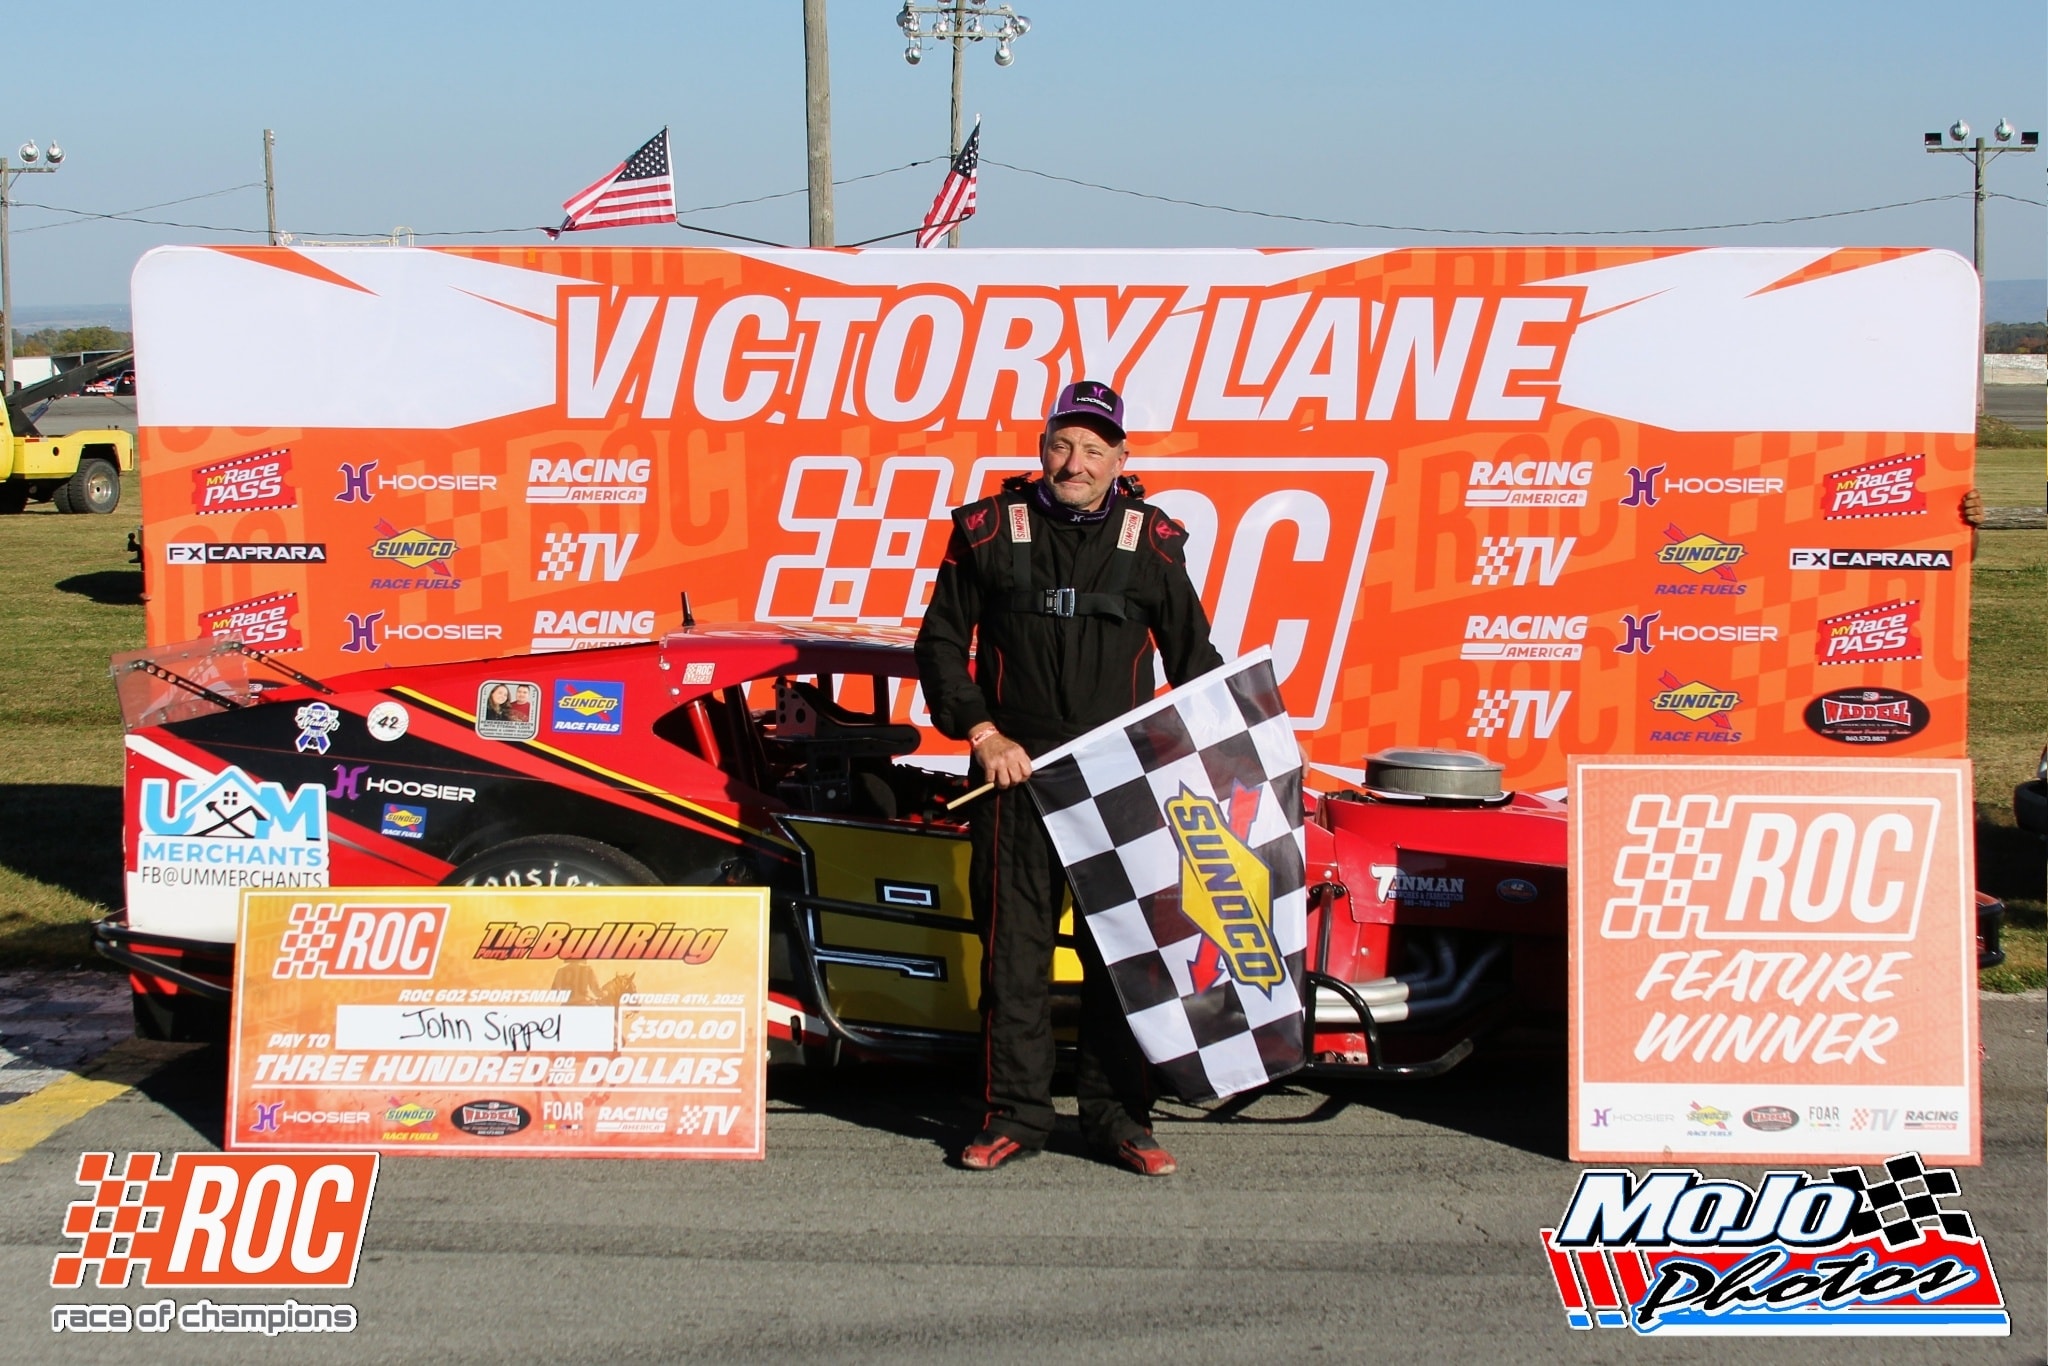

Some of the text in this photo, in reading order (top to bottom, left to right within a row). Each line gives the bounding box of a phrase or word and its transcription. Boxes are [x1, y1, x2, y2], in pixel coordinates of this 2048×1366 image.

[567, 293, 1573, 423] VICTORY LANE
[528, 459, 651, 483] RACING
[1470, 461, 1593, 486] RACING
[204, 478, 282, 507] PASS
[379, 475, 497, 490] HOOSIER
[1664, 478, 1784, 493] HOOSIER
[571, 489, 638, 501] AMERICA
[1512, 492, 1579, 504] AMERICA
[1832, 482, 1914, 512] PASS
[1016, 508, 1027, 540] SIMPSON
[1122, 512, 1139, 548] SIMPSON
[207, 546, 326, 560] CAPRARA
[375, 541, 452, 557] SUNOCO
[578, 533, 640, 582] TV
[1660, 544, 1741, 564] SUNOCO
[1513, 537, 1578, 586] TV
[1833, 552, 1952, 568] CAPRARA
[369, 578, 461, 590] RACE FUELS
[1655, 584, 1747, 595] RACE FUELS
[384, 624, 503, 640] HOOSIER
[533, 611, 654, 635] RACING
[1465, 615, 1588, 640] RACING
[1659, 625, 1778, 642] HOOSIER
[1826, 629, 1908, 657] PASS
[1506, 647, 1574, 659] AMERICA
[560, 697, 616, 711] SUNOCO
[1655, 692, 1735, 710] SUNOCO
[377, 715, 399, 729] 42
[1507, 690, 1572, 739] TV
[1823, 698, 1912, 726] WADDELL
[554, 721, 620, 733] RACE FUELS
[1649, 731, 1742, 743] RACE FUELS
[366, 777, 476, 803] HOOSIER
[387, 813, 421, 824] SUNOCO
[381, 828, 424, 839] RACE FUELS
[142, 842, 322, 867] MERCHANTS
[141, 865, 322, 888] FB@UMMERCHANTS
[1724, 811, 1914, 924] ROC
[1173, 802, 1284, 980] SUNOCO
[335, 911, 436, 971] ROC
[478, 921, 729, 966] The BullRing
[1634, 948, 1914, 1007] FEATURE
[398, 989, 432, 1003] ROC
[469, 989, 571, 1003] SPORTSMAN
[619, 993, 745, 1006] OCTOBER 4TH, 2025
[400, 1007, 473, 1043] John
[626, 1016, 737, 1043] $300.00
[267, 1033, 331, 1048] PAY TO
[1633, 1011, 1900, 1065] WINNER
[253, 1054, 743, 1086] THREE HUNDRED 00 100 DOLLARS
[282, 1111, 371, 1123] HOOSIER
[386, 1108, 436, 1121] SUNOCO
[462, 1105, 521, 1126] WADDELL
[542, 1101, 585, 1121] FOAR
[598, 1106, 669, 1121] RACING
[701, 1105, 741, 1136] TV
[1613, 1112, 1675, 1123] HOOSIER
[1688, 1110, 1731, 1122] SUNOCO
[1809, 1106, 1840, 1120] FOAR
[1869, 1109, 1900, 1131] TV
[1905, 1110, 1959, 1122] RACING
[382, 1131, 440, 1141] RACE FUELS
